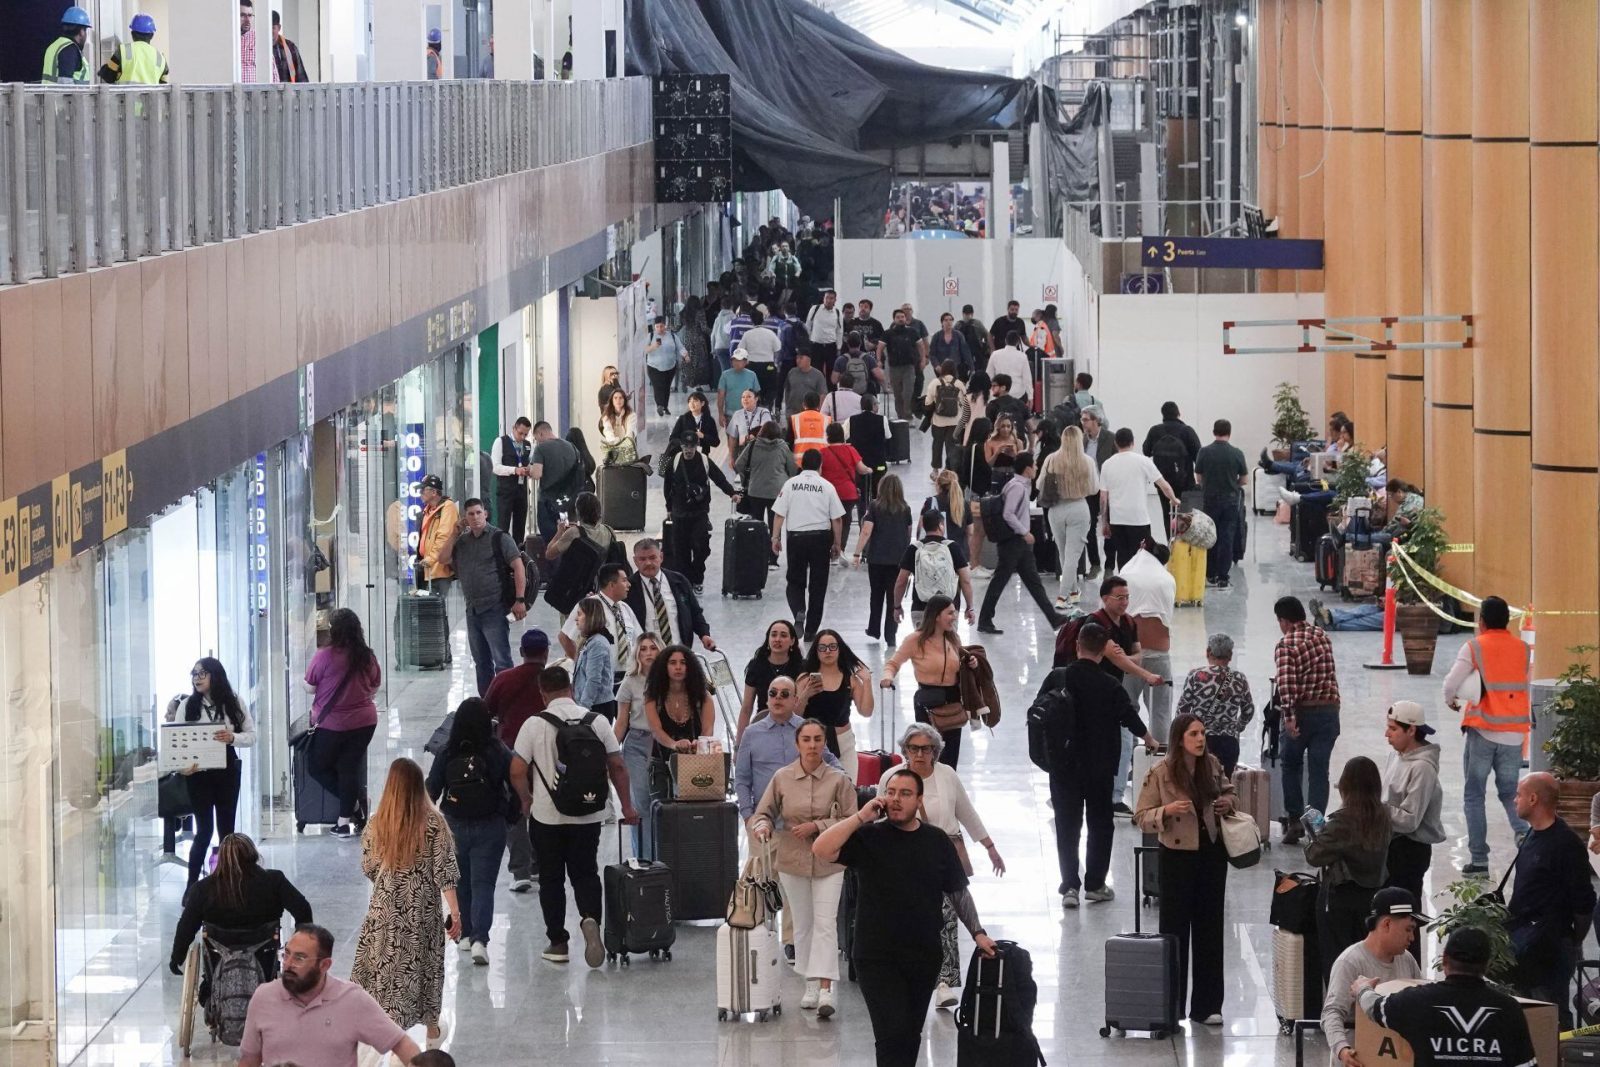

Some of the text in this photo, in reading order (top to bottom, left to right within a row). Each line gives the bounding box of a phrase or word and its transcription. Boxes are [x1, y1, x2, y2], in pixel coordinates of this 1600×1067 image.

[1163, 241, 1176, 262] 3
[104, 465, 125, 524] F1-F3
[791, 482, 823, 494] MARINA
[664, 889, 672, 925] NAUTICA
[1378, 1036, 1398, 1060] A
[1429, 1037, 1502, 1054] VICRA
